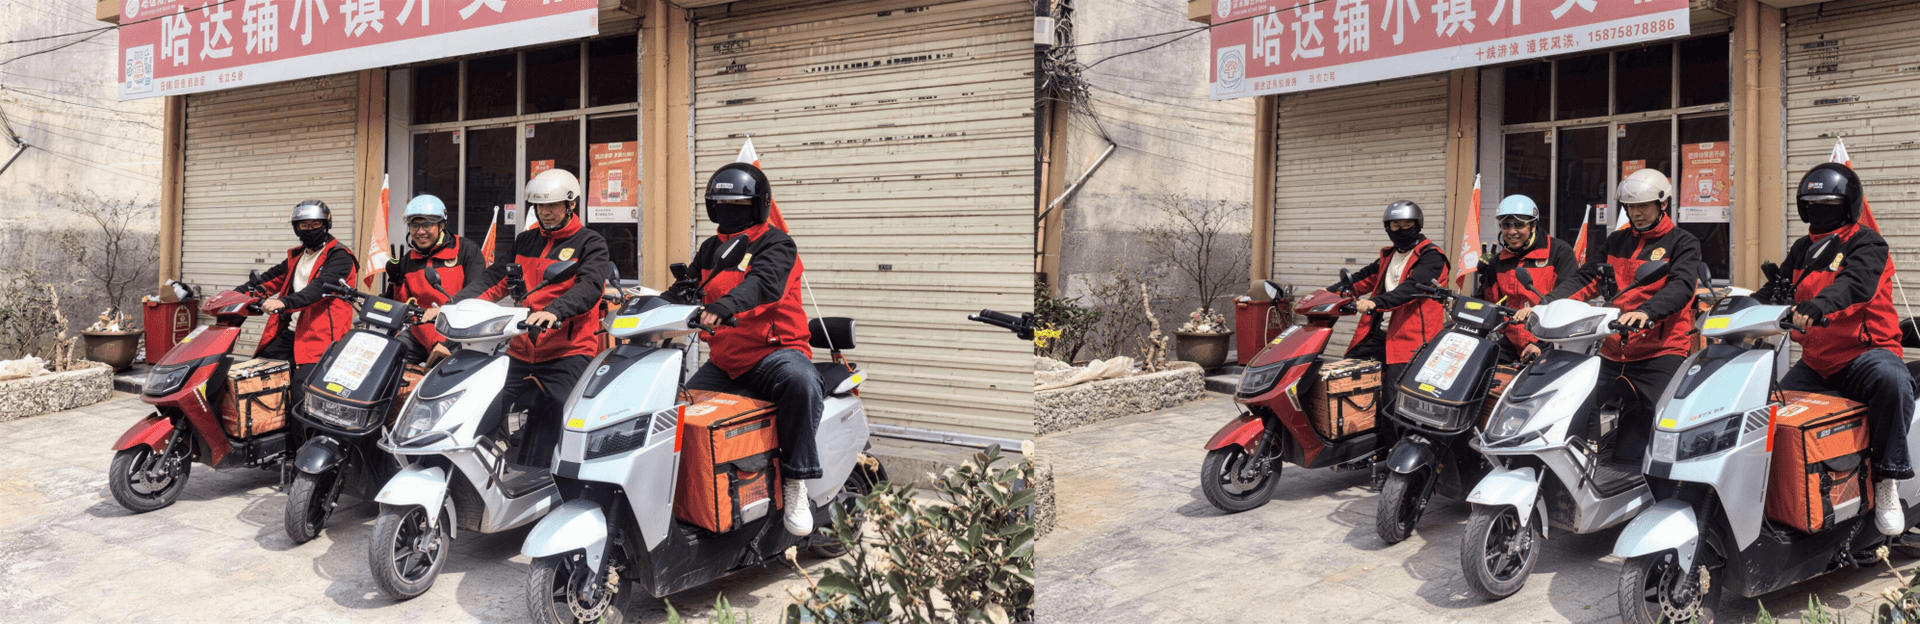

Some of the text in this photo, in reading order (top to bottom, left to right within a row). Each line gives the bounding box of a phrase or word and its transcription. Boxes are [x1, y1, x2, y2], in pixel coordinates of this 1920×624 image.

[161, 0, 562, 67] 哈达铺小镇
[1252, 0, 1652, 67] 哈达铺小镇
[1588, 18, 1675, 43] 15875878886
